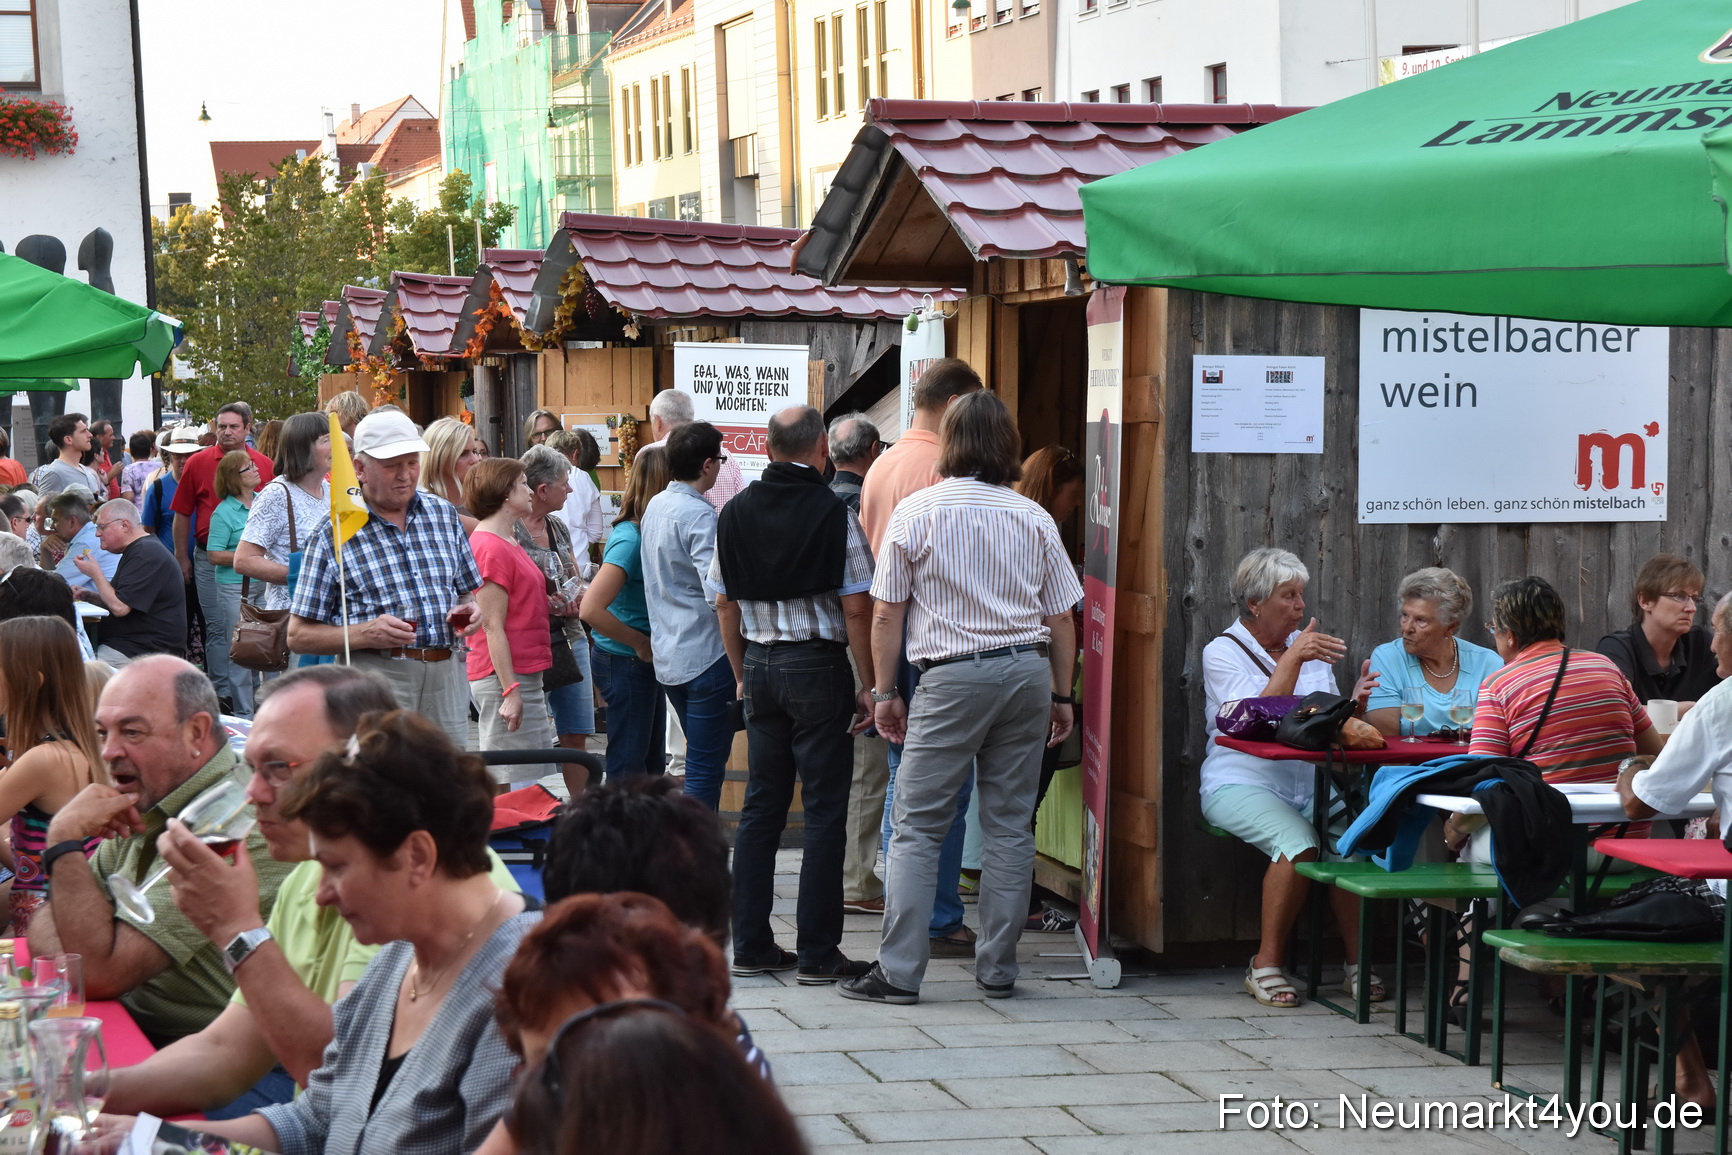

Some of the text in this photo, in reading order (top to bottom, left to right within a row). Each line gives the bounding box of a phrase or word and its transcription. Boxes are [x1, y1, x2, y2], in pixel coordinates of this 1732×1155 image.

[1402, 63, 1410, 76] 9.
[1412, 59, 1428, 75] und
[1382, 317, 1640, 353] mistelbacher
[694, 365, 789, 381] EGAL, WAS, WANN
[693, 380, 789, 397] UND WO SIE FEIERN
[1380, 373, 1477, 408] wein
[715, 393, 767, 412] MÖCHTEN:
[1365, 500, 1400, 513] ganz
[1402, 497, 1442, 510] schön
[1447, 497, 1489, 510] leben.
[1493, 499, 1527, 513] ganz
[1530, 497, 1570, 510] schön
[1573, 496, 1646, 509] mistelbach
